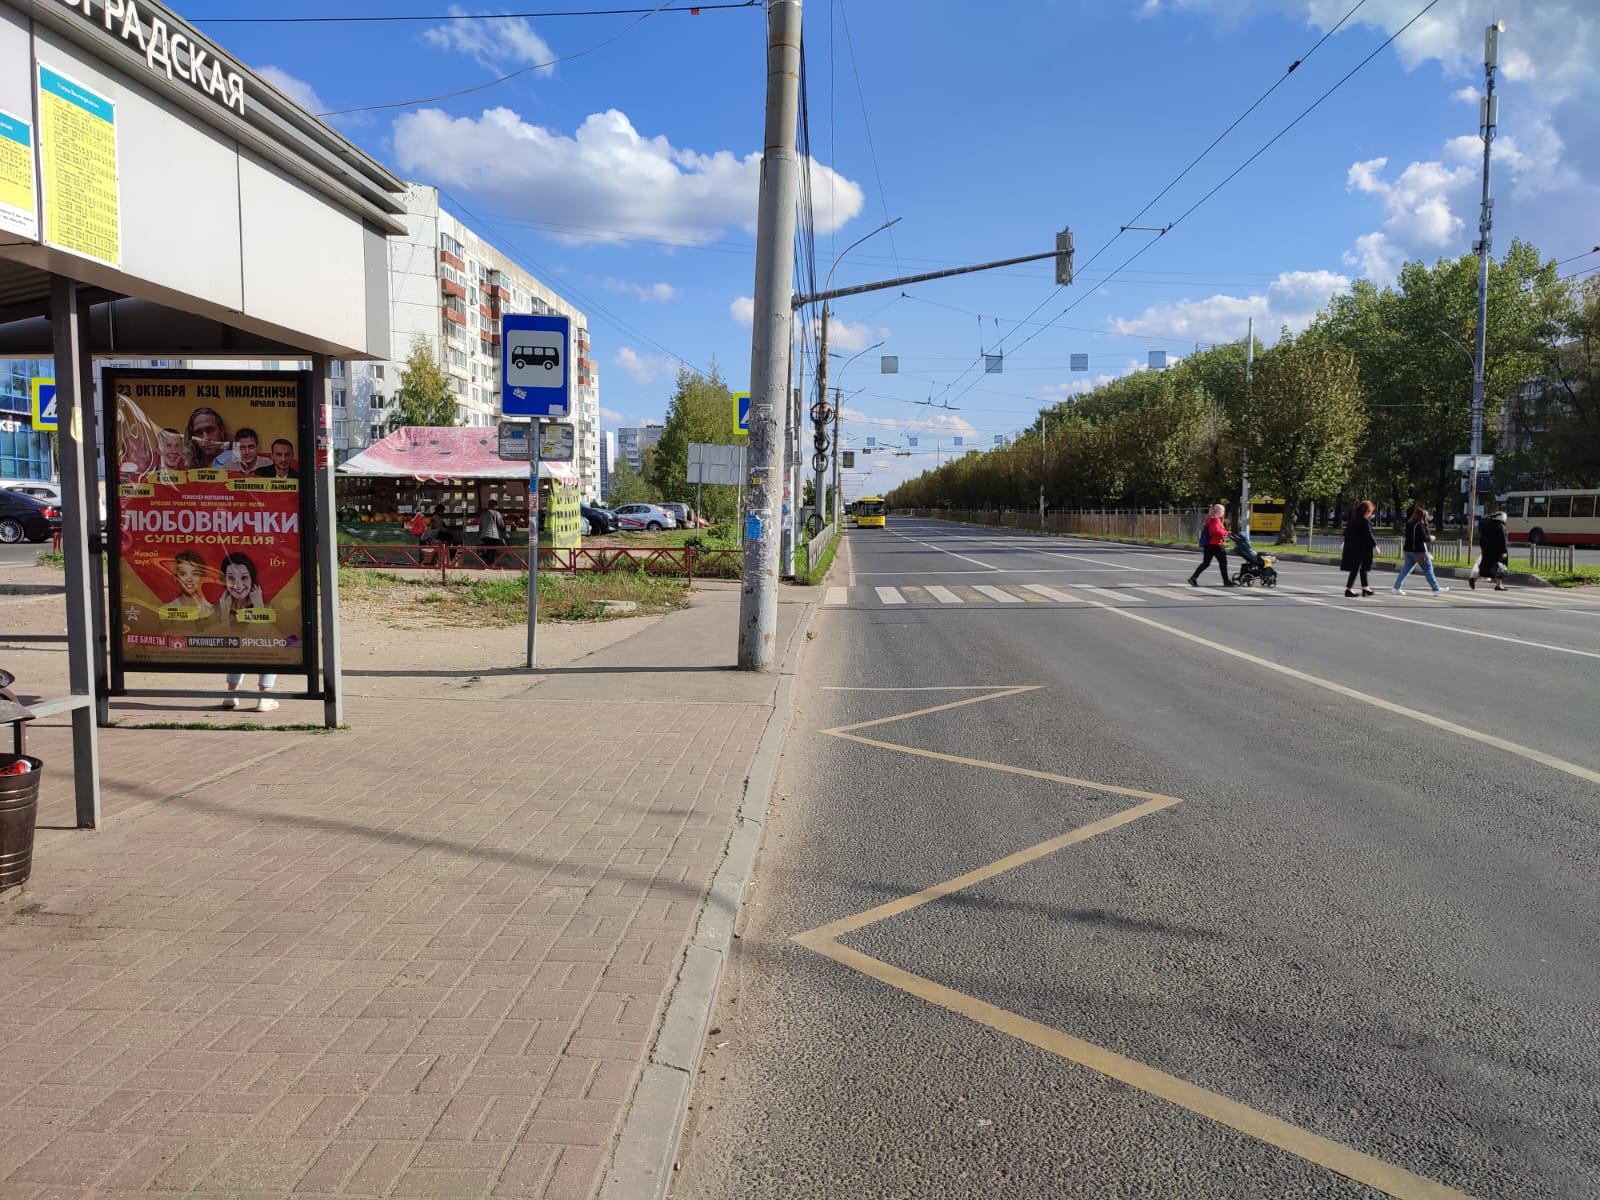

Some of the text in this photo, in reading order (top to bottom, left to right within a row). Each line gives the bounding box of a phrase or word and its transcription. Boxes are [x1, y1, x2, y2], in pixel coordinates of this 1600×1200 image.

[64, 0, 245, 115] РАДСКАЯ
[118, 384, 131, 397] 23
[136, 384, 186, 398] ОКТЯБРЯ
[225, 385, 296, 399] МИЛЛЕНИУМ
[250, 400, 276, 408] НАЧАЛО
[125, 510, 298, 533] ЛЮБОВНИЧКИ
[144, 534, 275, 545] СУПЕРКОМЕДИЯ
[133, 550, 159, 558] Живой
[270, 557, 287, 567] 16+
[127, 635, 165, 646] ВСЕ БИЛЕТЫ
[188, 637, 224, 648] ЯРКОНЦЕРТ
